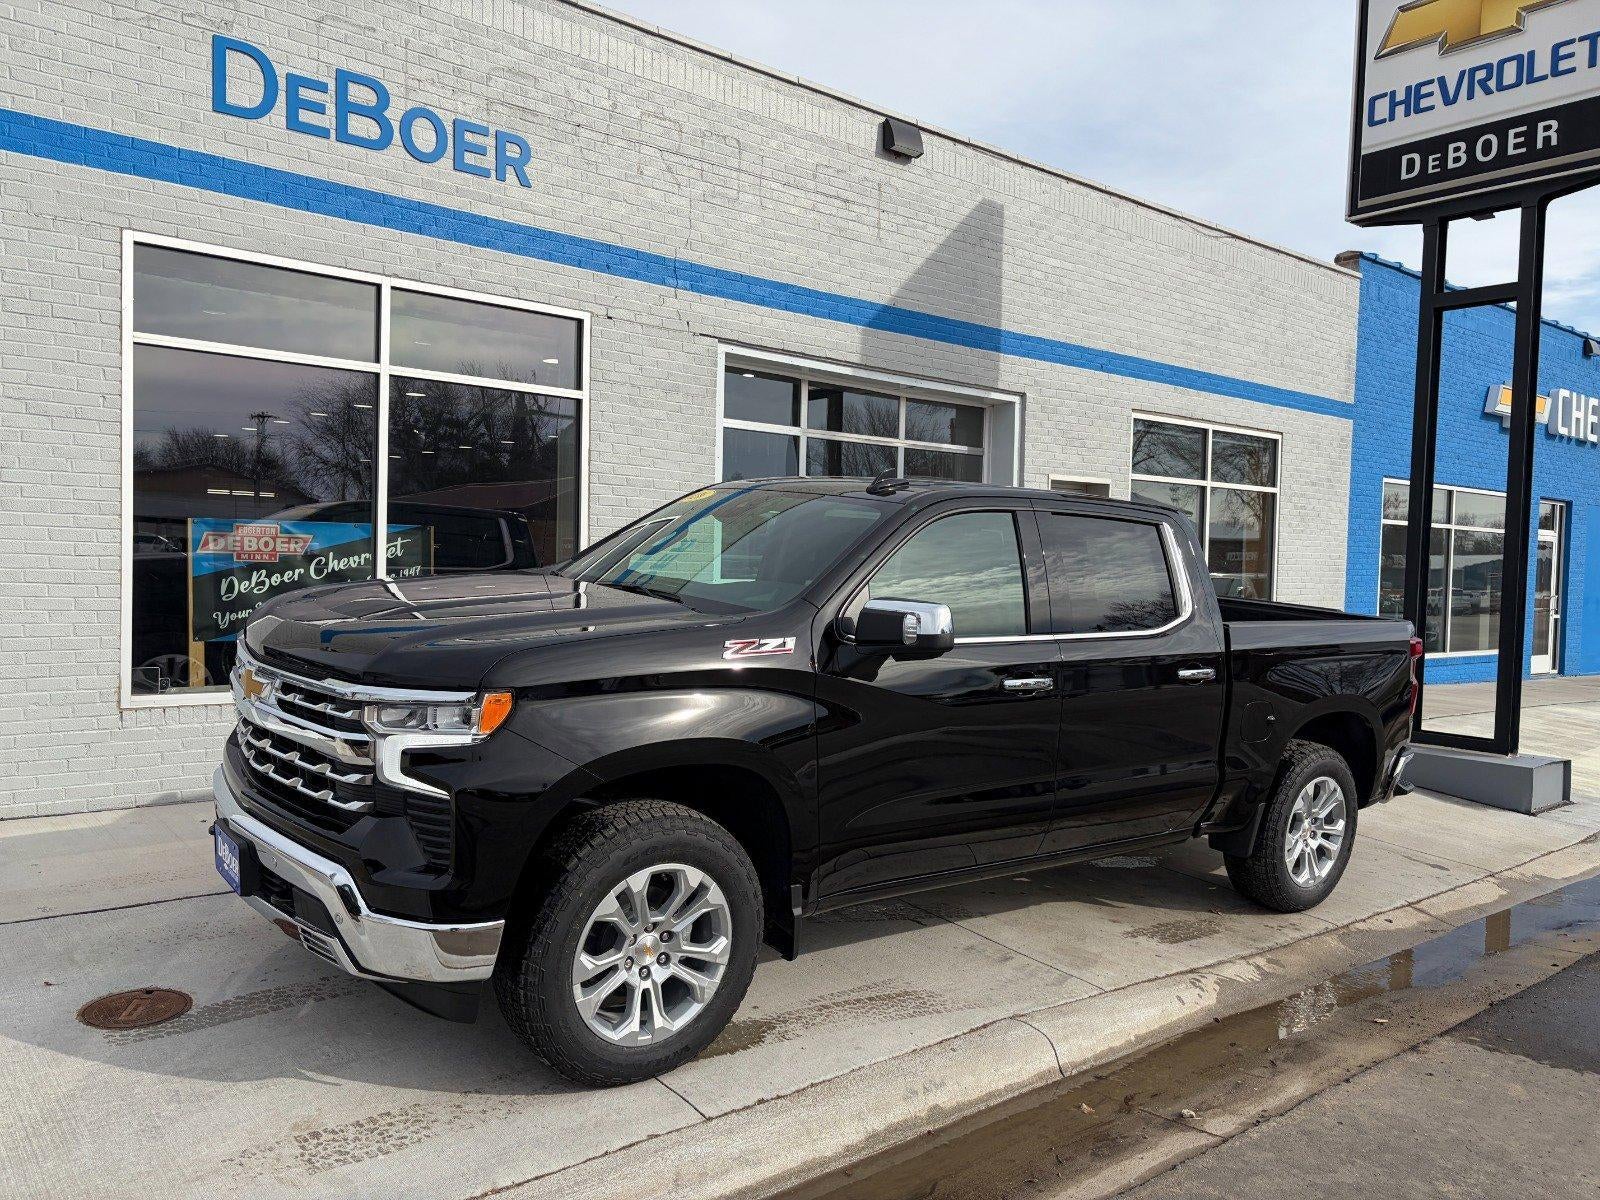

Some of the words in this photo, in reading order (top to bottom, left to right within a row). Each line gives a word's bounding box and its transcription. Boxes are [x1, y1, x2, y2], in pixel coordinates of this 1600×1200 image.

[1367, 30, 1600, 127] CHEVROLET
[238, 526, 276, 536] EDGERTON
[208, 535, 304, 552] DEBOER
[220, 567, 304, 602] DeBoer
[309, 537, 411, 580] Chevret
[400, 565, 421, 578] 1947
[213, 608, 252, 629] Your
